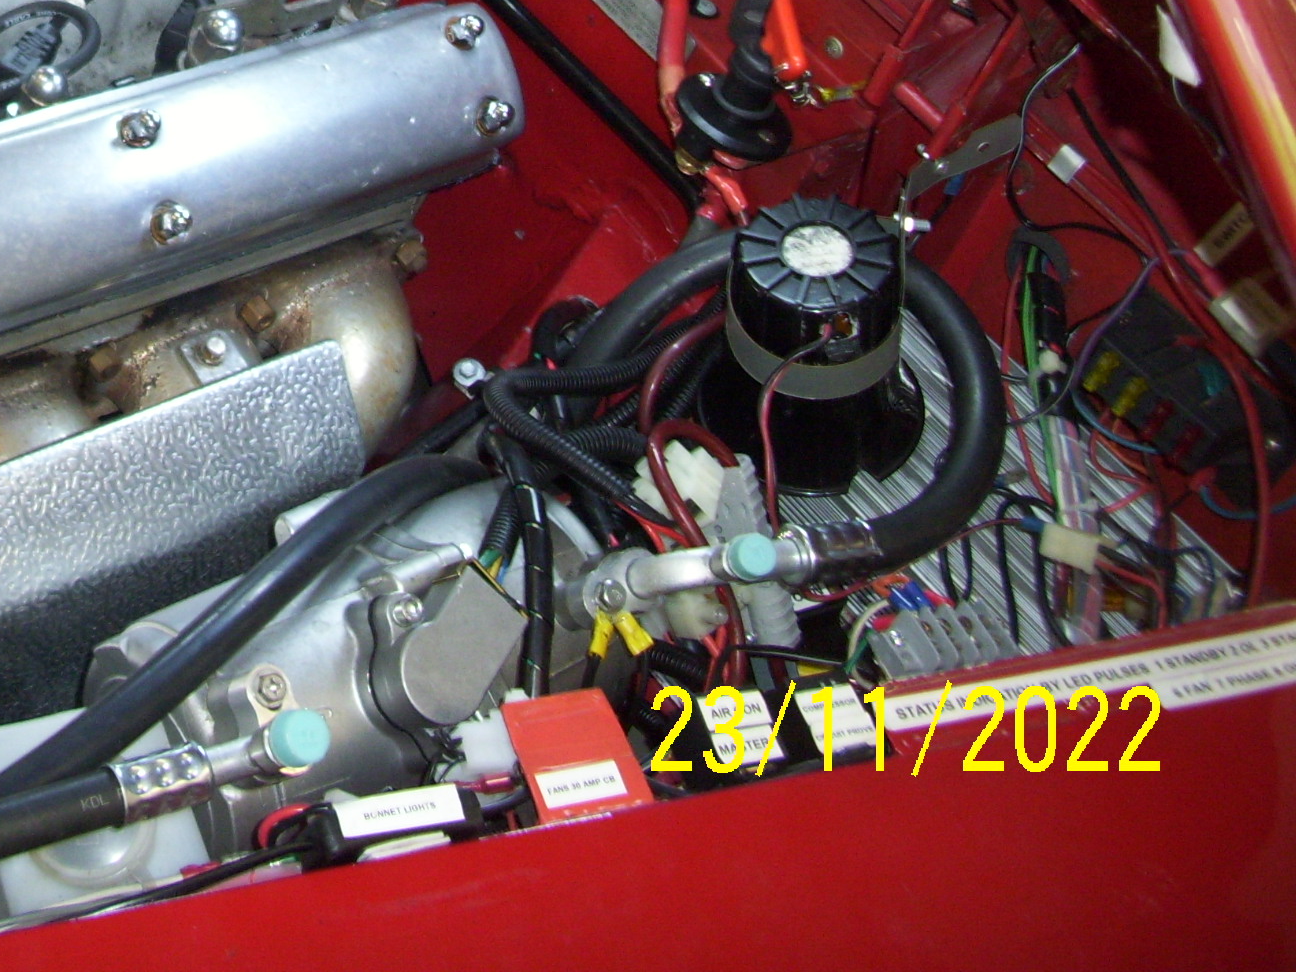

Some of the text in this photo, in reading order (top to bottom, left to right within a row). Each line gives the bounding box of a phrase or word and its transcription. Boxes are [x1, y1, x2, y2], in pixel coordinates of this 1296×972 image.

[1063, 671, 1093, 690] LED
[711, 708, 731, 719] AIR
[547, 784, 570, 796] FANS
[584, 778, 604, 789] AMP
[80, 793, 110, 812] KDL
[403, 802, 436, 814] LIGHTS
